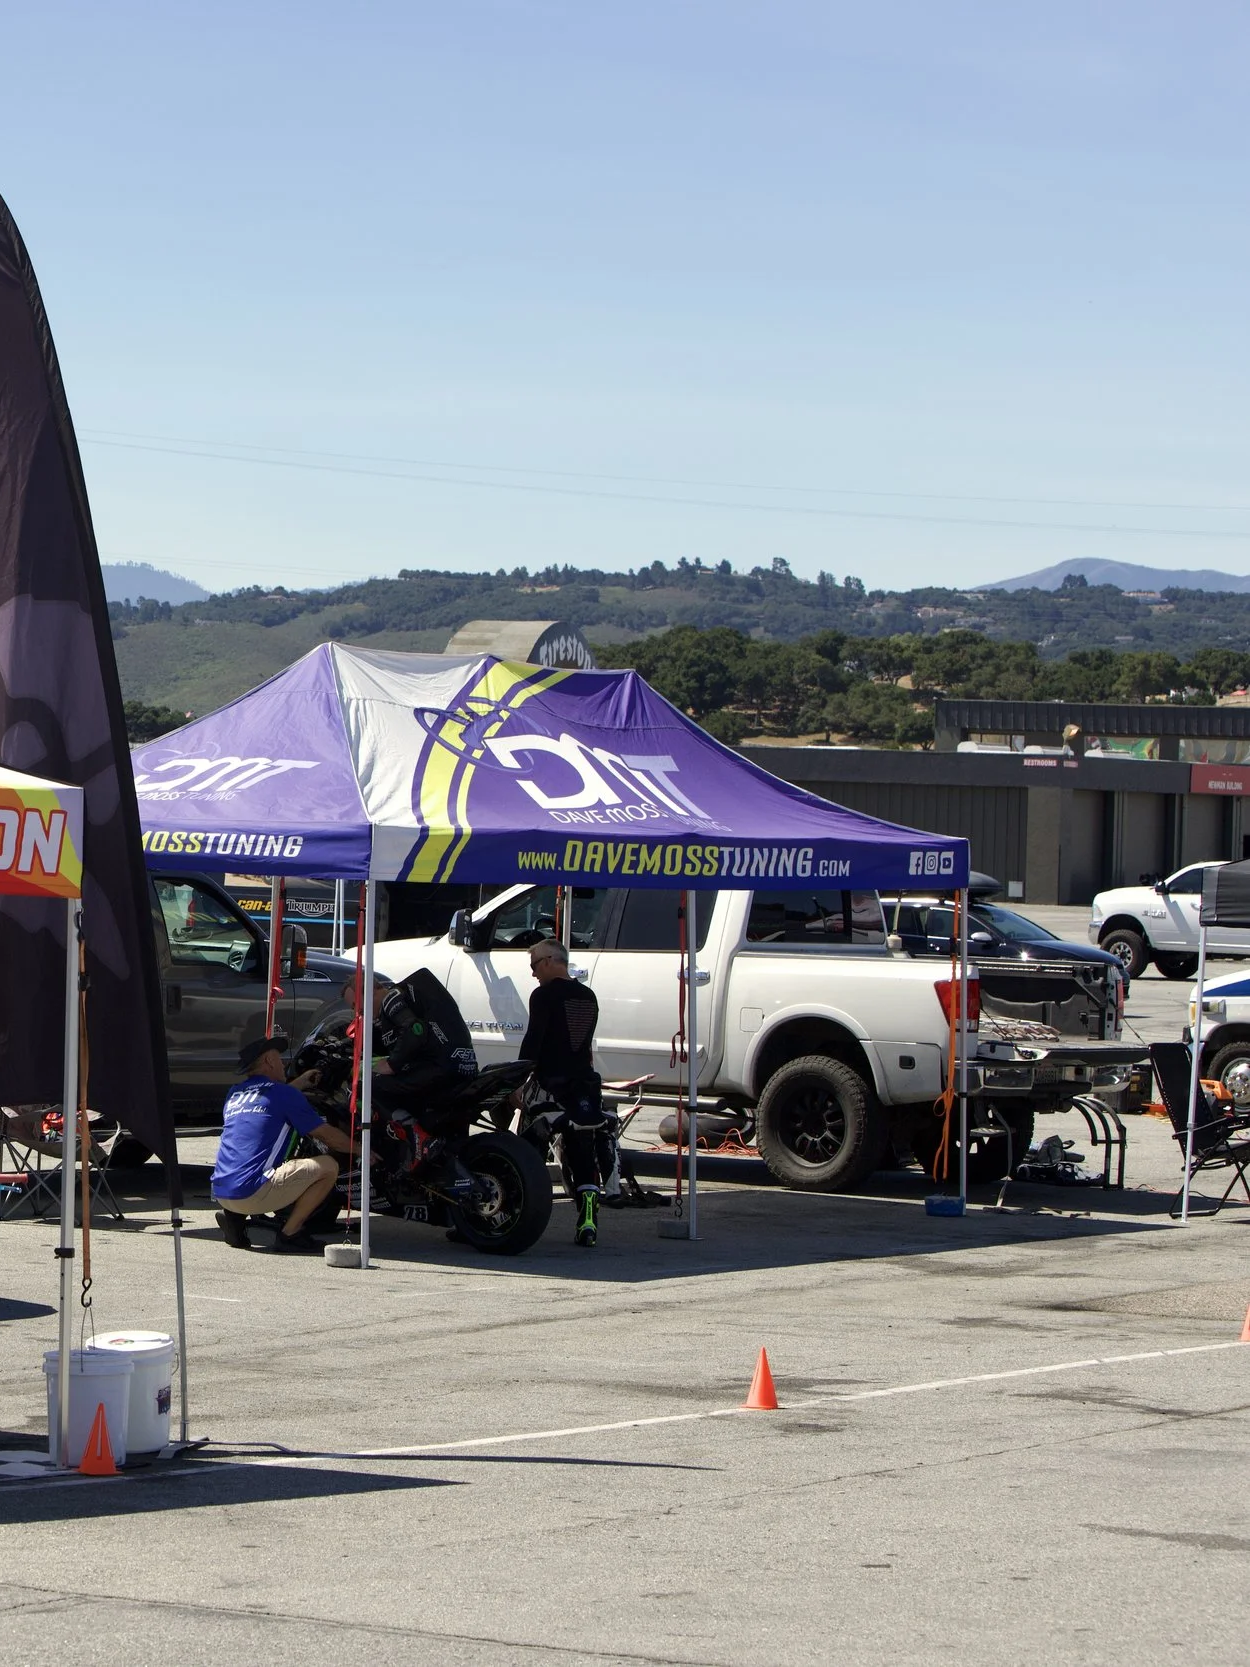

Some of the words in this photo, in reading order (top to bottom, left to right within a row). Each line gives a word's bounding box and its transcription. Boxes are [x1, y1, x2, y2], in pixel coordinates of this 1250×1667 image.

[539, 634, 596, 670] Fireston
[1023, 758, 1058, 767] RESTROOMS
[549, 809, 610, 824] DAVE
